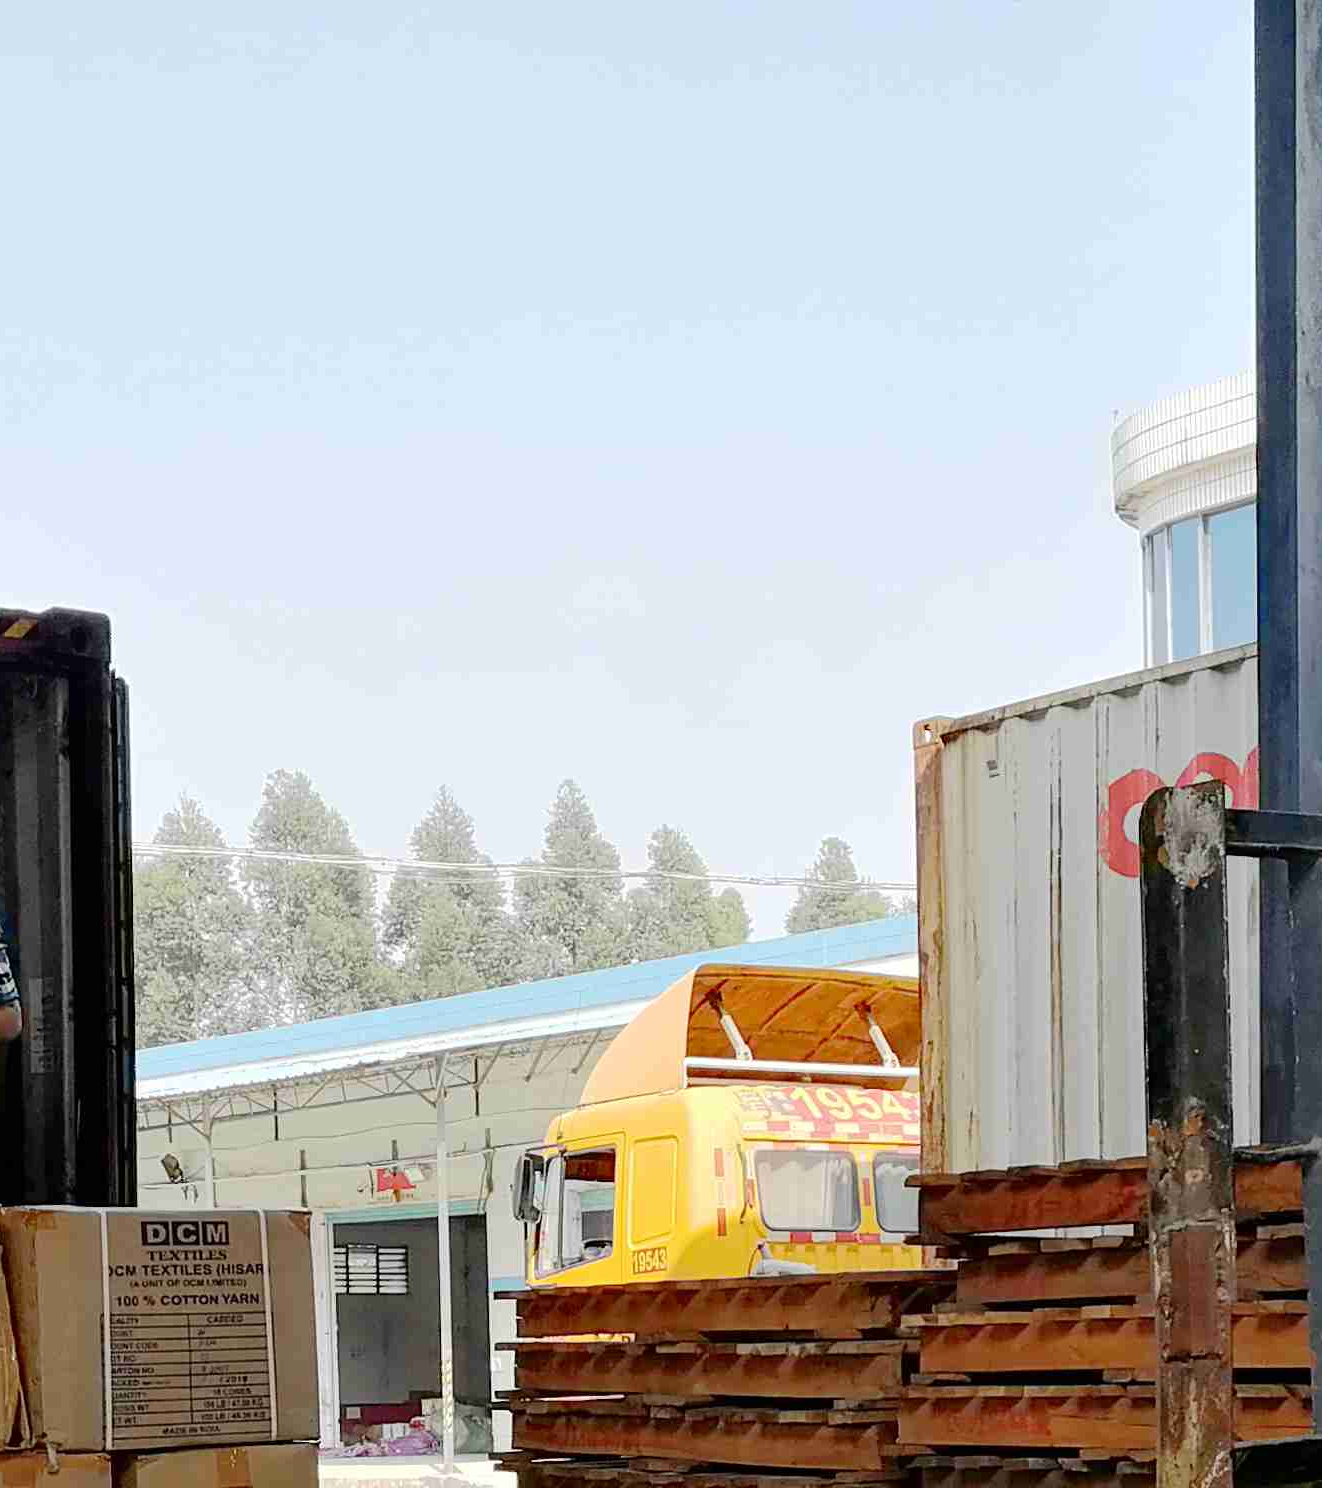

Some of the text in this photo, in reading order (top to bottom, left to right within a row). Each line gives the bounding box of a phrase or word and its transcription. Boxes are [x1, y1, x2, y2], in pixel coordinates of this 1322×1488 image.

[142, 1221, 229, 1246] DCM
[148, 1250, 228, 1262] TEXTILES
[632, 1250, 667, 1273] 19543
[143, 1263, 212, 1277] TEXTILES
[117, 1296, 139, 1306] 100
[161, 1294, 218, 1306] COTTON
[222, 1293, 260, 1305] YARN
